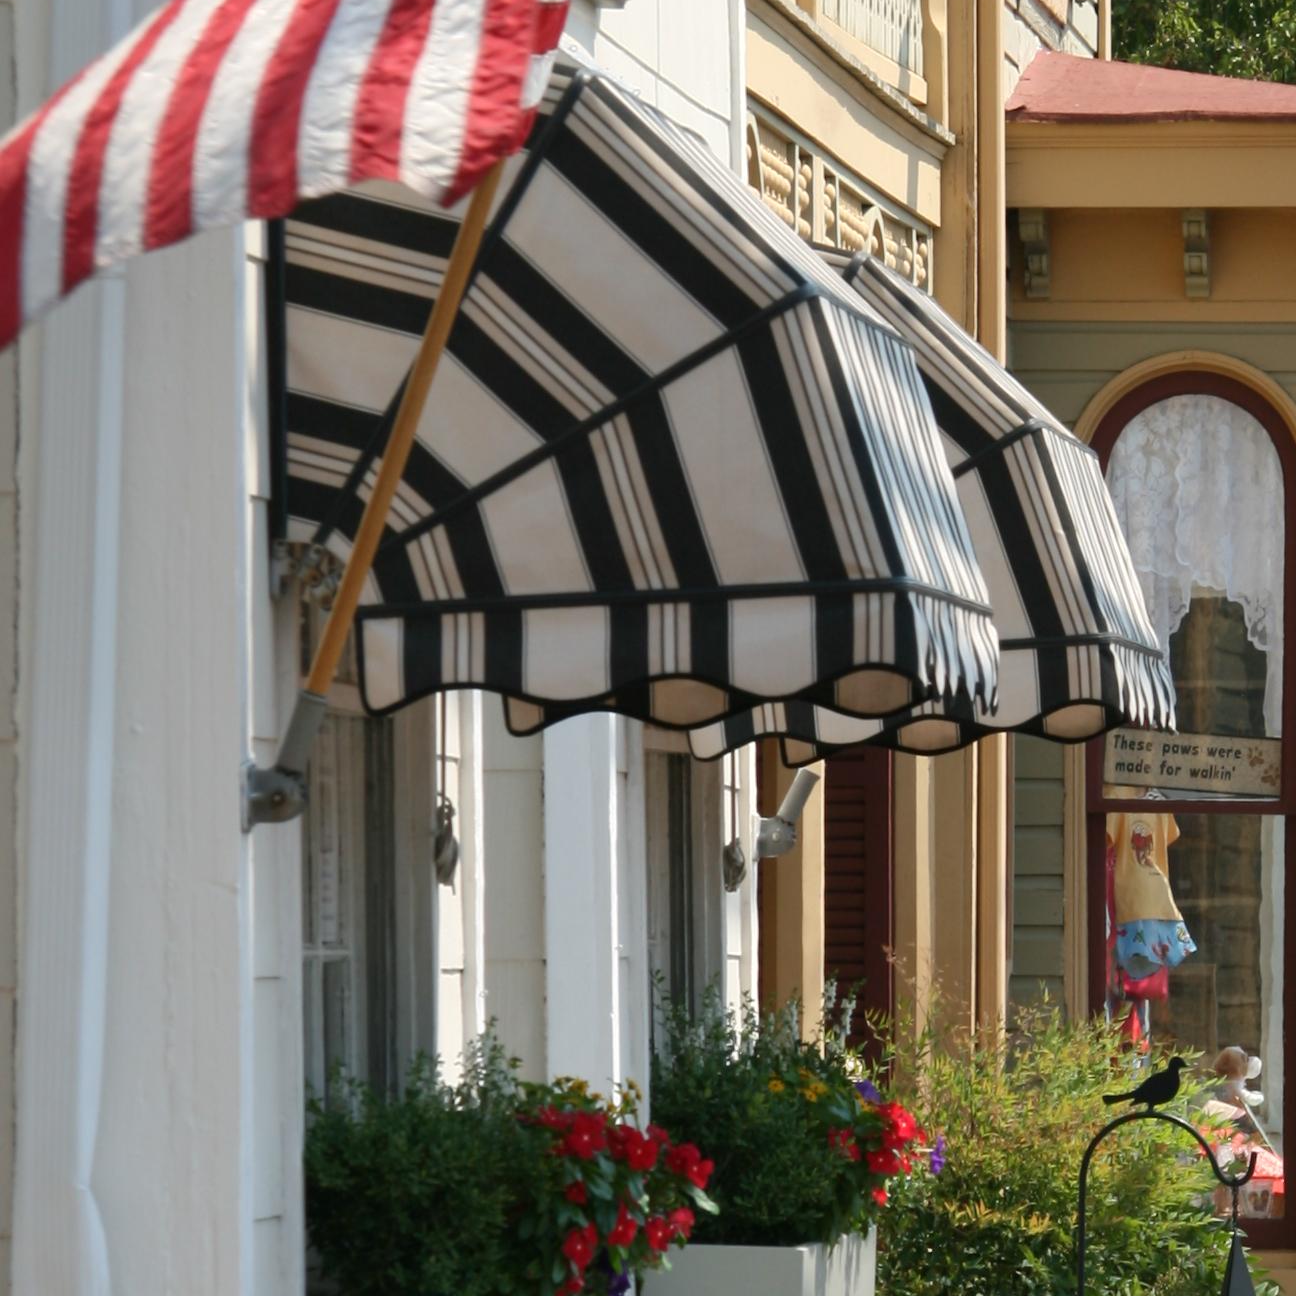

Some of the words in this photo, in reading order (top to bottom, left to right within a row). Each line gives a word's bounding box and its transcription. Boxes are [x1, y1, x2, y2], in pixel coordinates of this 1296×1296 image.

[1114, 734, 1153, 752] These
[1162, 743, 1199, 757] paws
[1207, 746, 1242, 759] were
[1115, 759, 1151, 774] made
[1160, 760, 1182, 776] for
[1189, 765, 1236, 781] walkin'
